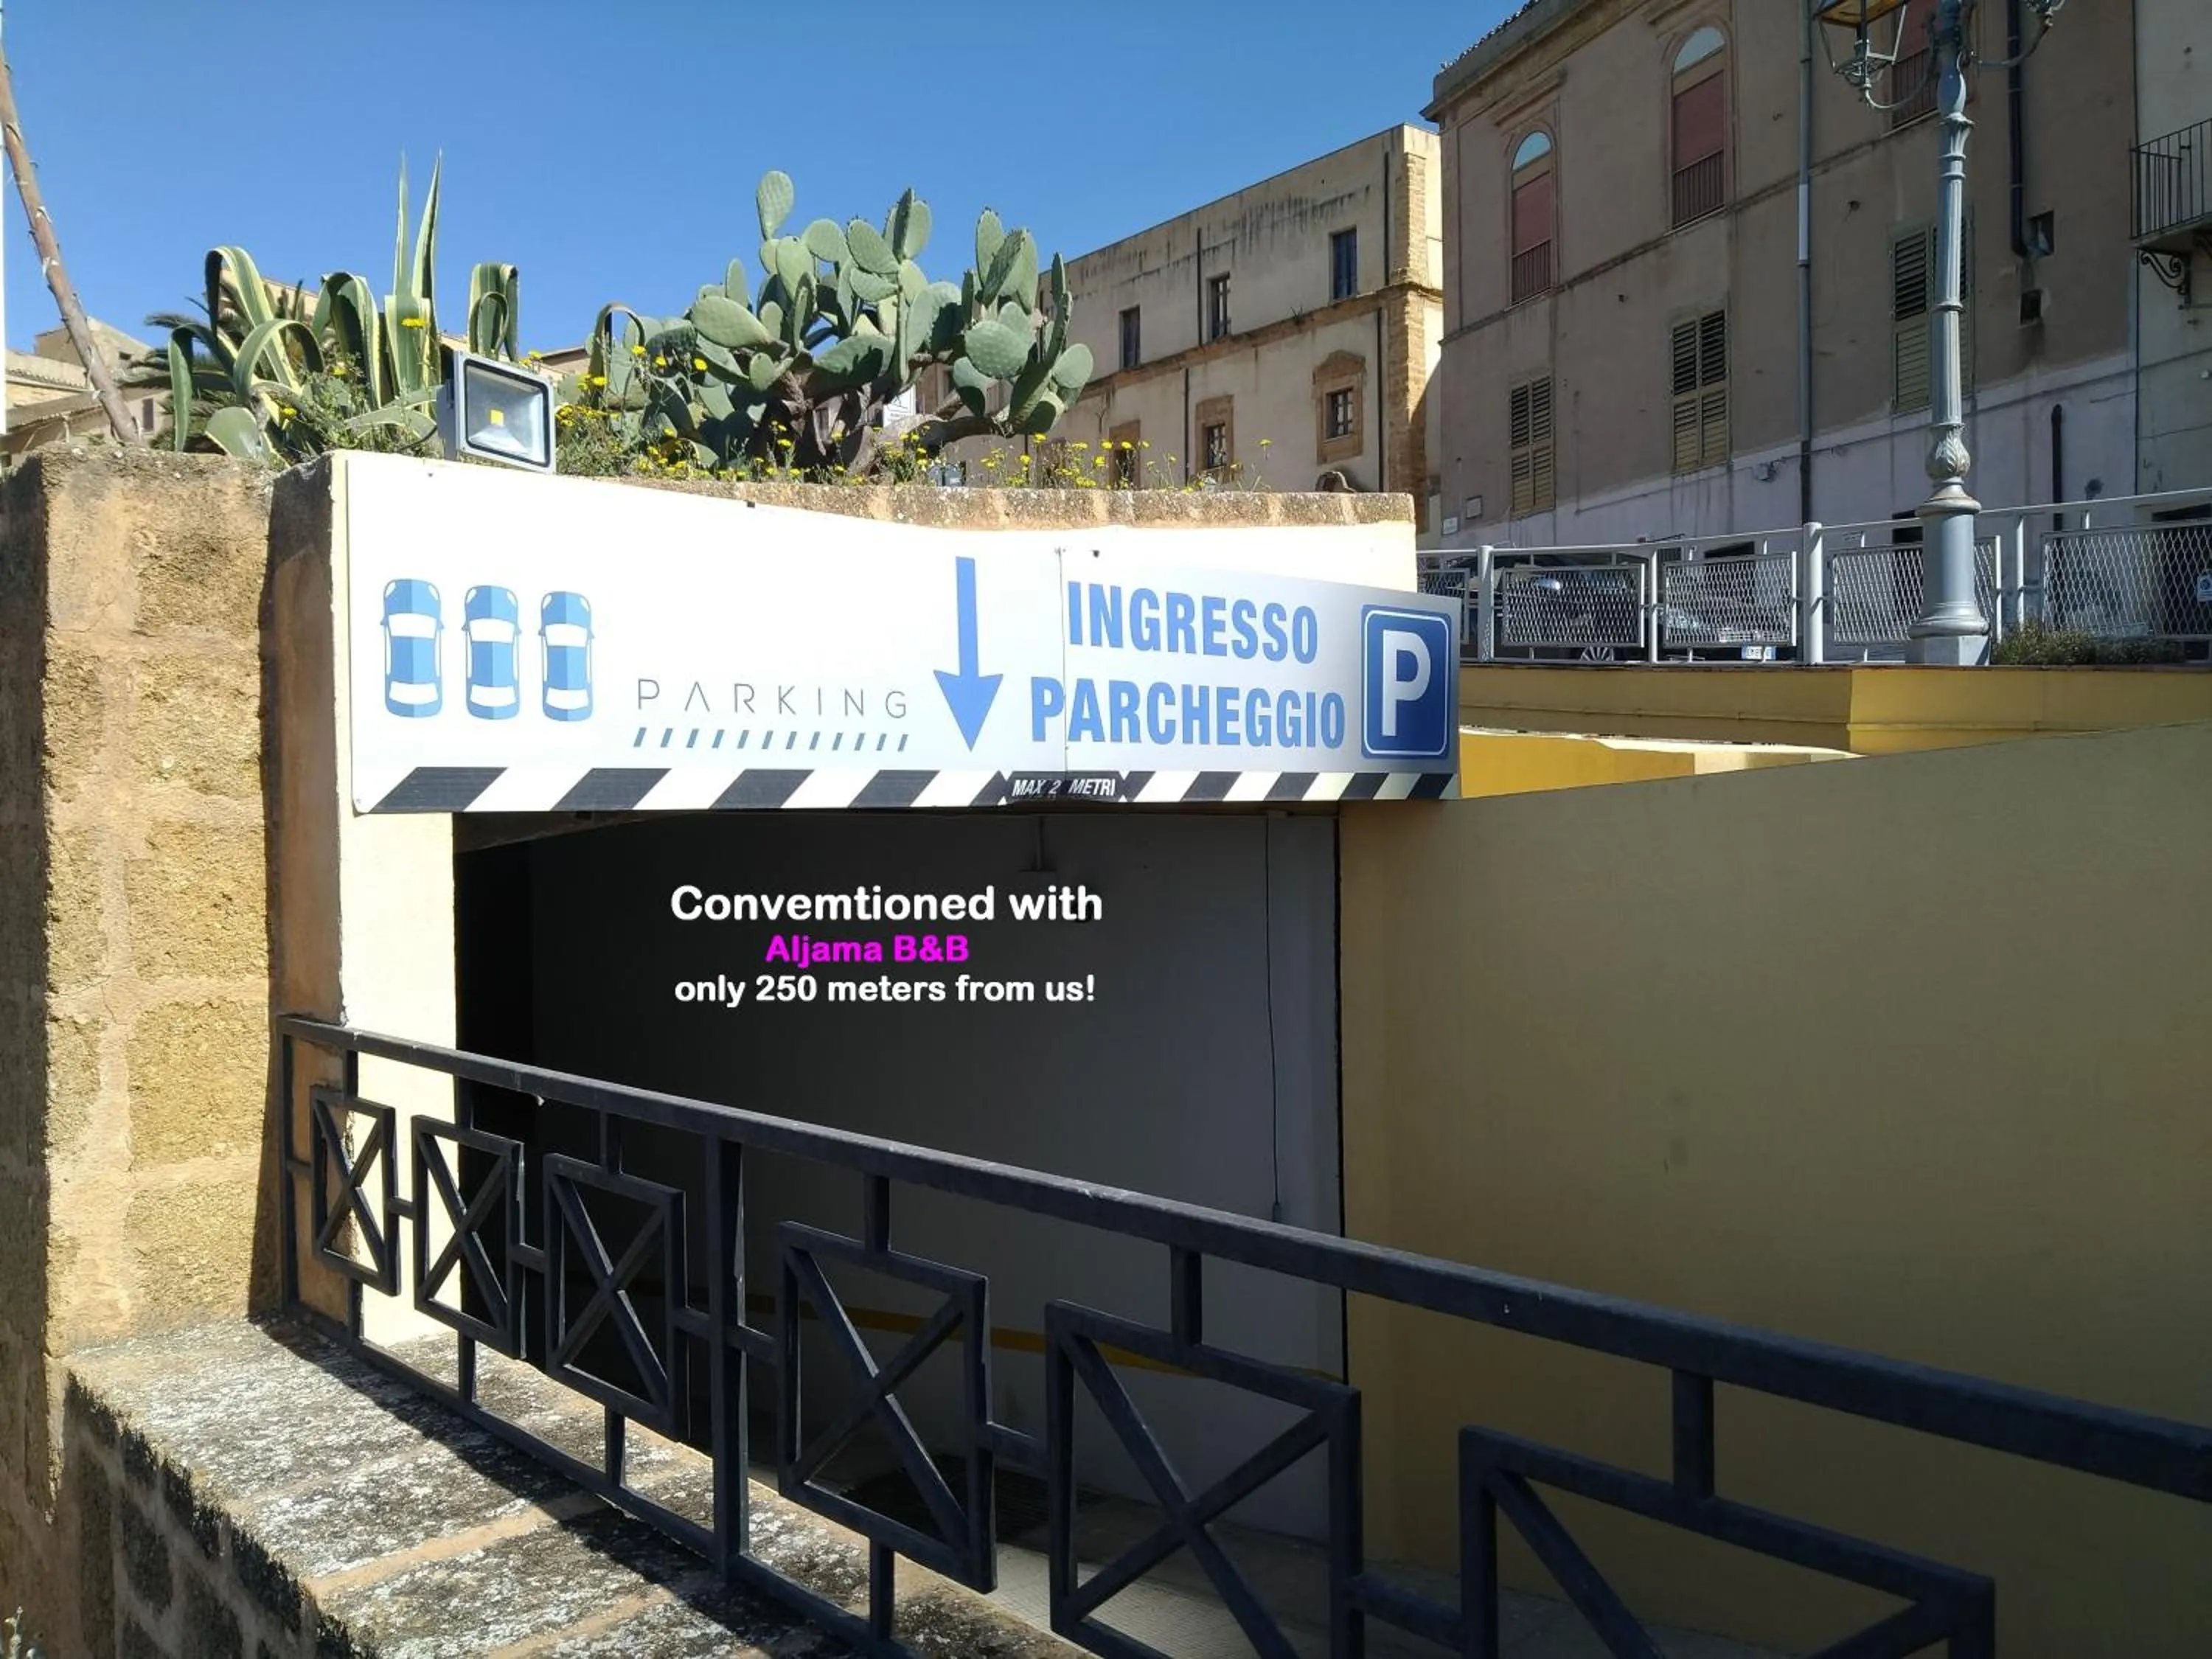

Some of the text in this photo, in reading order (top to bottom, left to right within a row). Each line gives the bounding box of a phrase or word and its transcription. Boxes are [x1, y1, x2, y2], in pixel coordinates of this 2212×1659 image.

[1068, 581, 1318, 664] INGRESSO
[638, 678, 907, 720] PARKING
[1031, 676, 1346, 750] PARCHEGGIO
[1381, 629, 1431, 737] P
[1012, 779, 1047, 796] MAX
[1068, 778, 1116, 796] METRI
